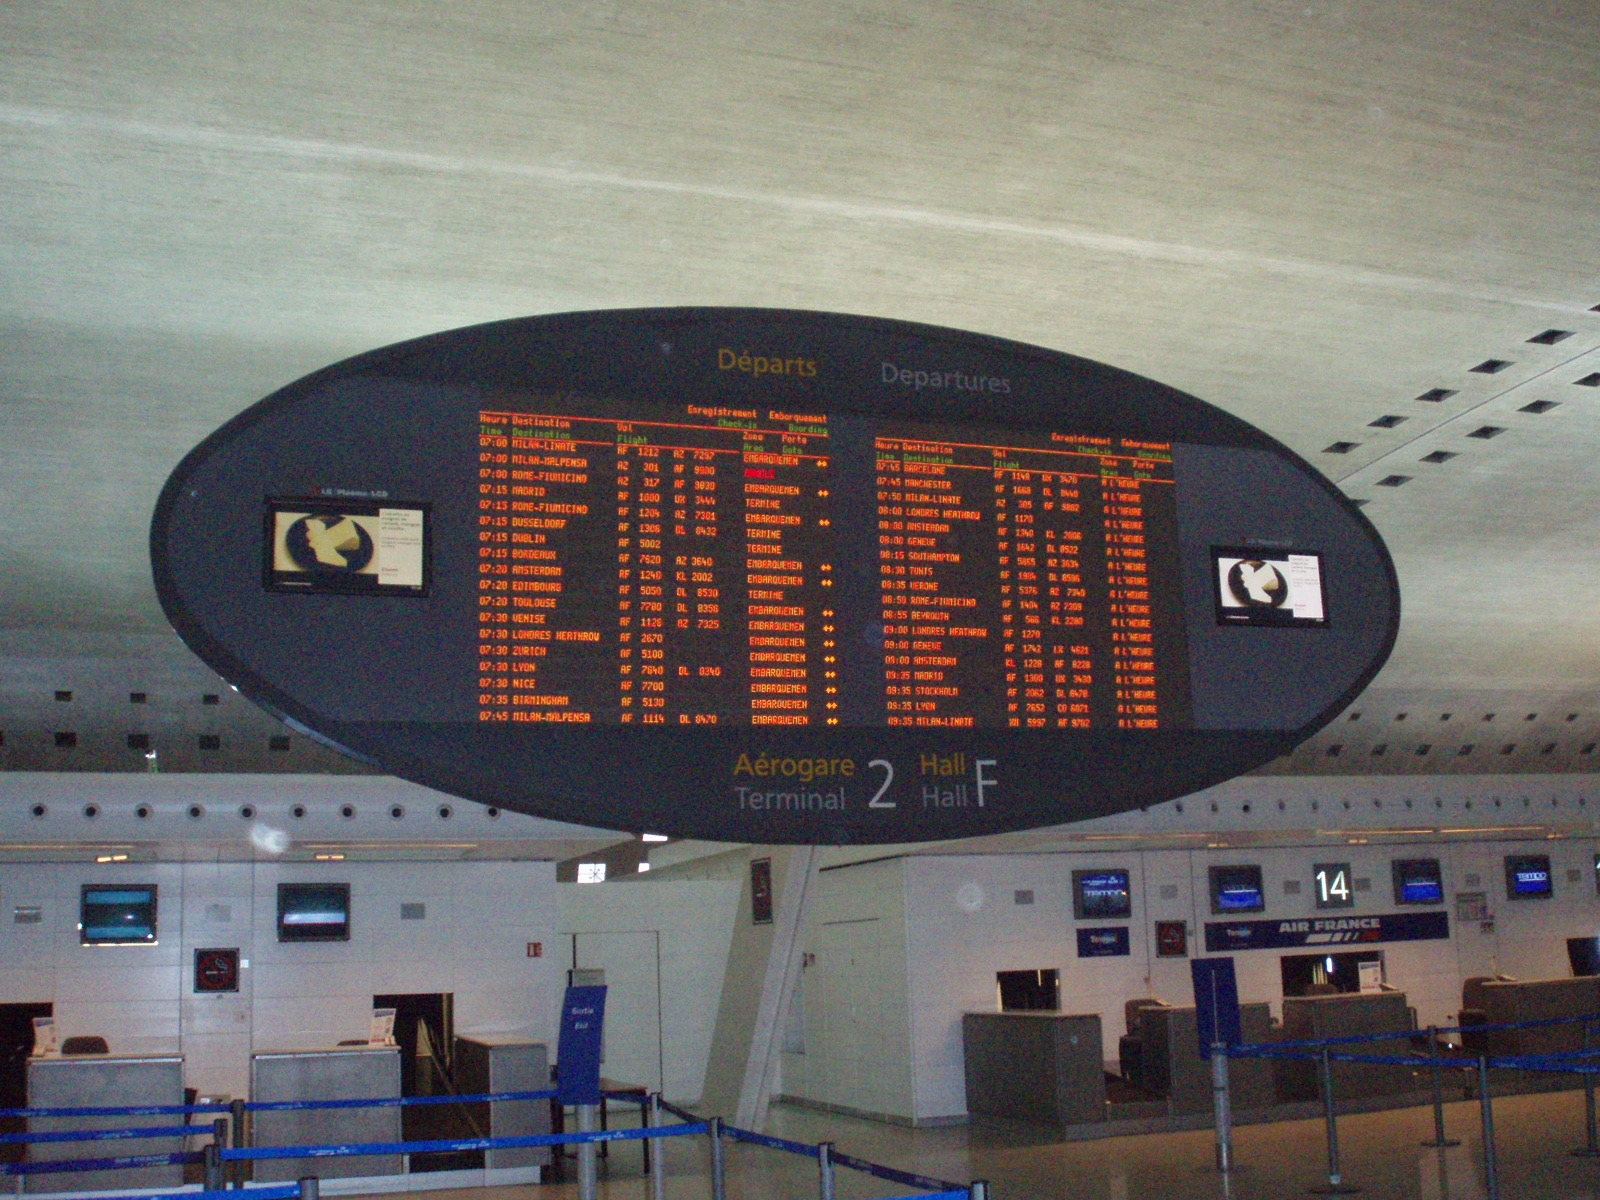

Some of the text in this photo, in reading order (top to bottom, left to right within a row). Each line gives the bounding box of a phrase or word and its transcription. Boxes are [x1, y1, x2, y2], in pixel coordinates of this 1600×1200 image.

[717, 349, 818, 377] Départs
[882, 361, 1011, 394] Departures
[480, 437, 508, 448] 07:00
[480, 453, 508, 463] 07:00
[480, 469, 508, 479] 07:00
[480, 484, 508, 494] 07:15
[480, 500, 508, 510] 07:15
[479, 516, 508, 526] 07:15
[480, 532, 507, 542] 07:15
[480, 548, 508, 558] 07:15
[479, 564, 508, 574] 07:20
[479, 580, 508, 590] 07:20
[479, 596, 508, 606] 07:20
[479, 612, 508, 622] 07:30
[479, 629, 508, 639] 07:30
[479, 645, 508, 655] 07:30
[479, 661, 508, 671] 07:30
[480, 678, 508, 688] 07:30
[479, 694, 508, 704] 07:35
[479, 711, 508, 721] 07:45
[733, 752, 998, 808] Aérogare 2 Hall F
[735, 784, 967, 811] Terminal Hall
[1316, 870, 1349, 901] 14
[1279, 918, 1381, 933] AIR FRANCE
